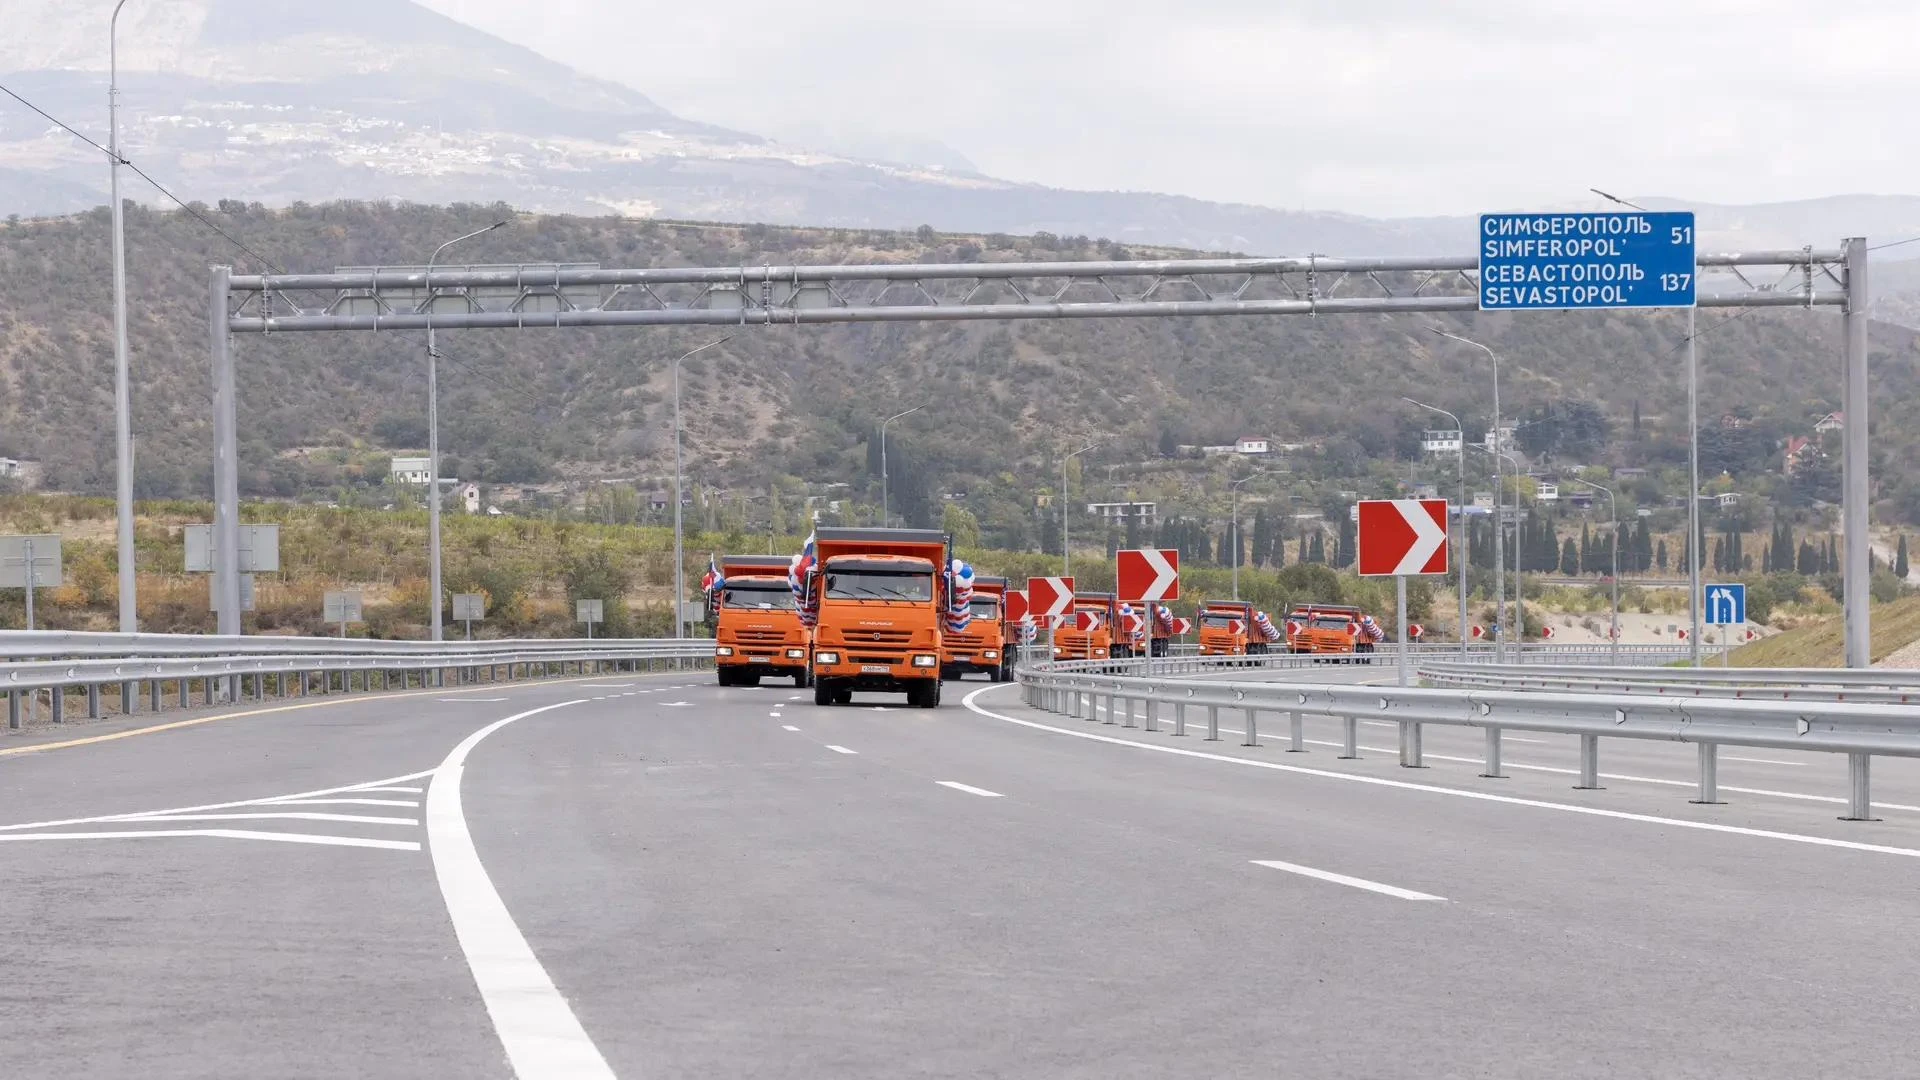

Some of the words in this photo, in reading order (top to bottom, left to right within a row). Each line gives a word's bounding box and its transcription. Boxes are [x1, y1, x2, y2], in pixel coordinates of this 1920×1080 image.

[1484, 216, 1652, 236] СИМФЕРОПОЛЬ
[1671, 226, 1691, 245] 51
[1484, 263, 1645, 283] СЕВАСТОПОЛЬ
[1660, 273, 1691, 292] 137
